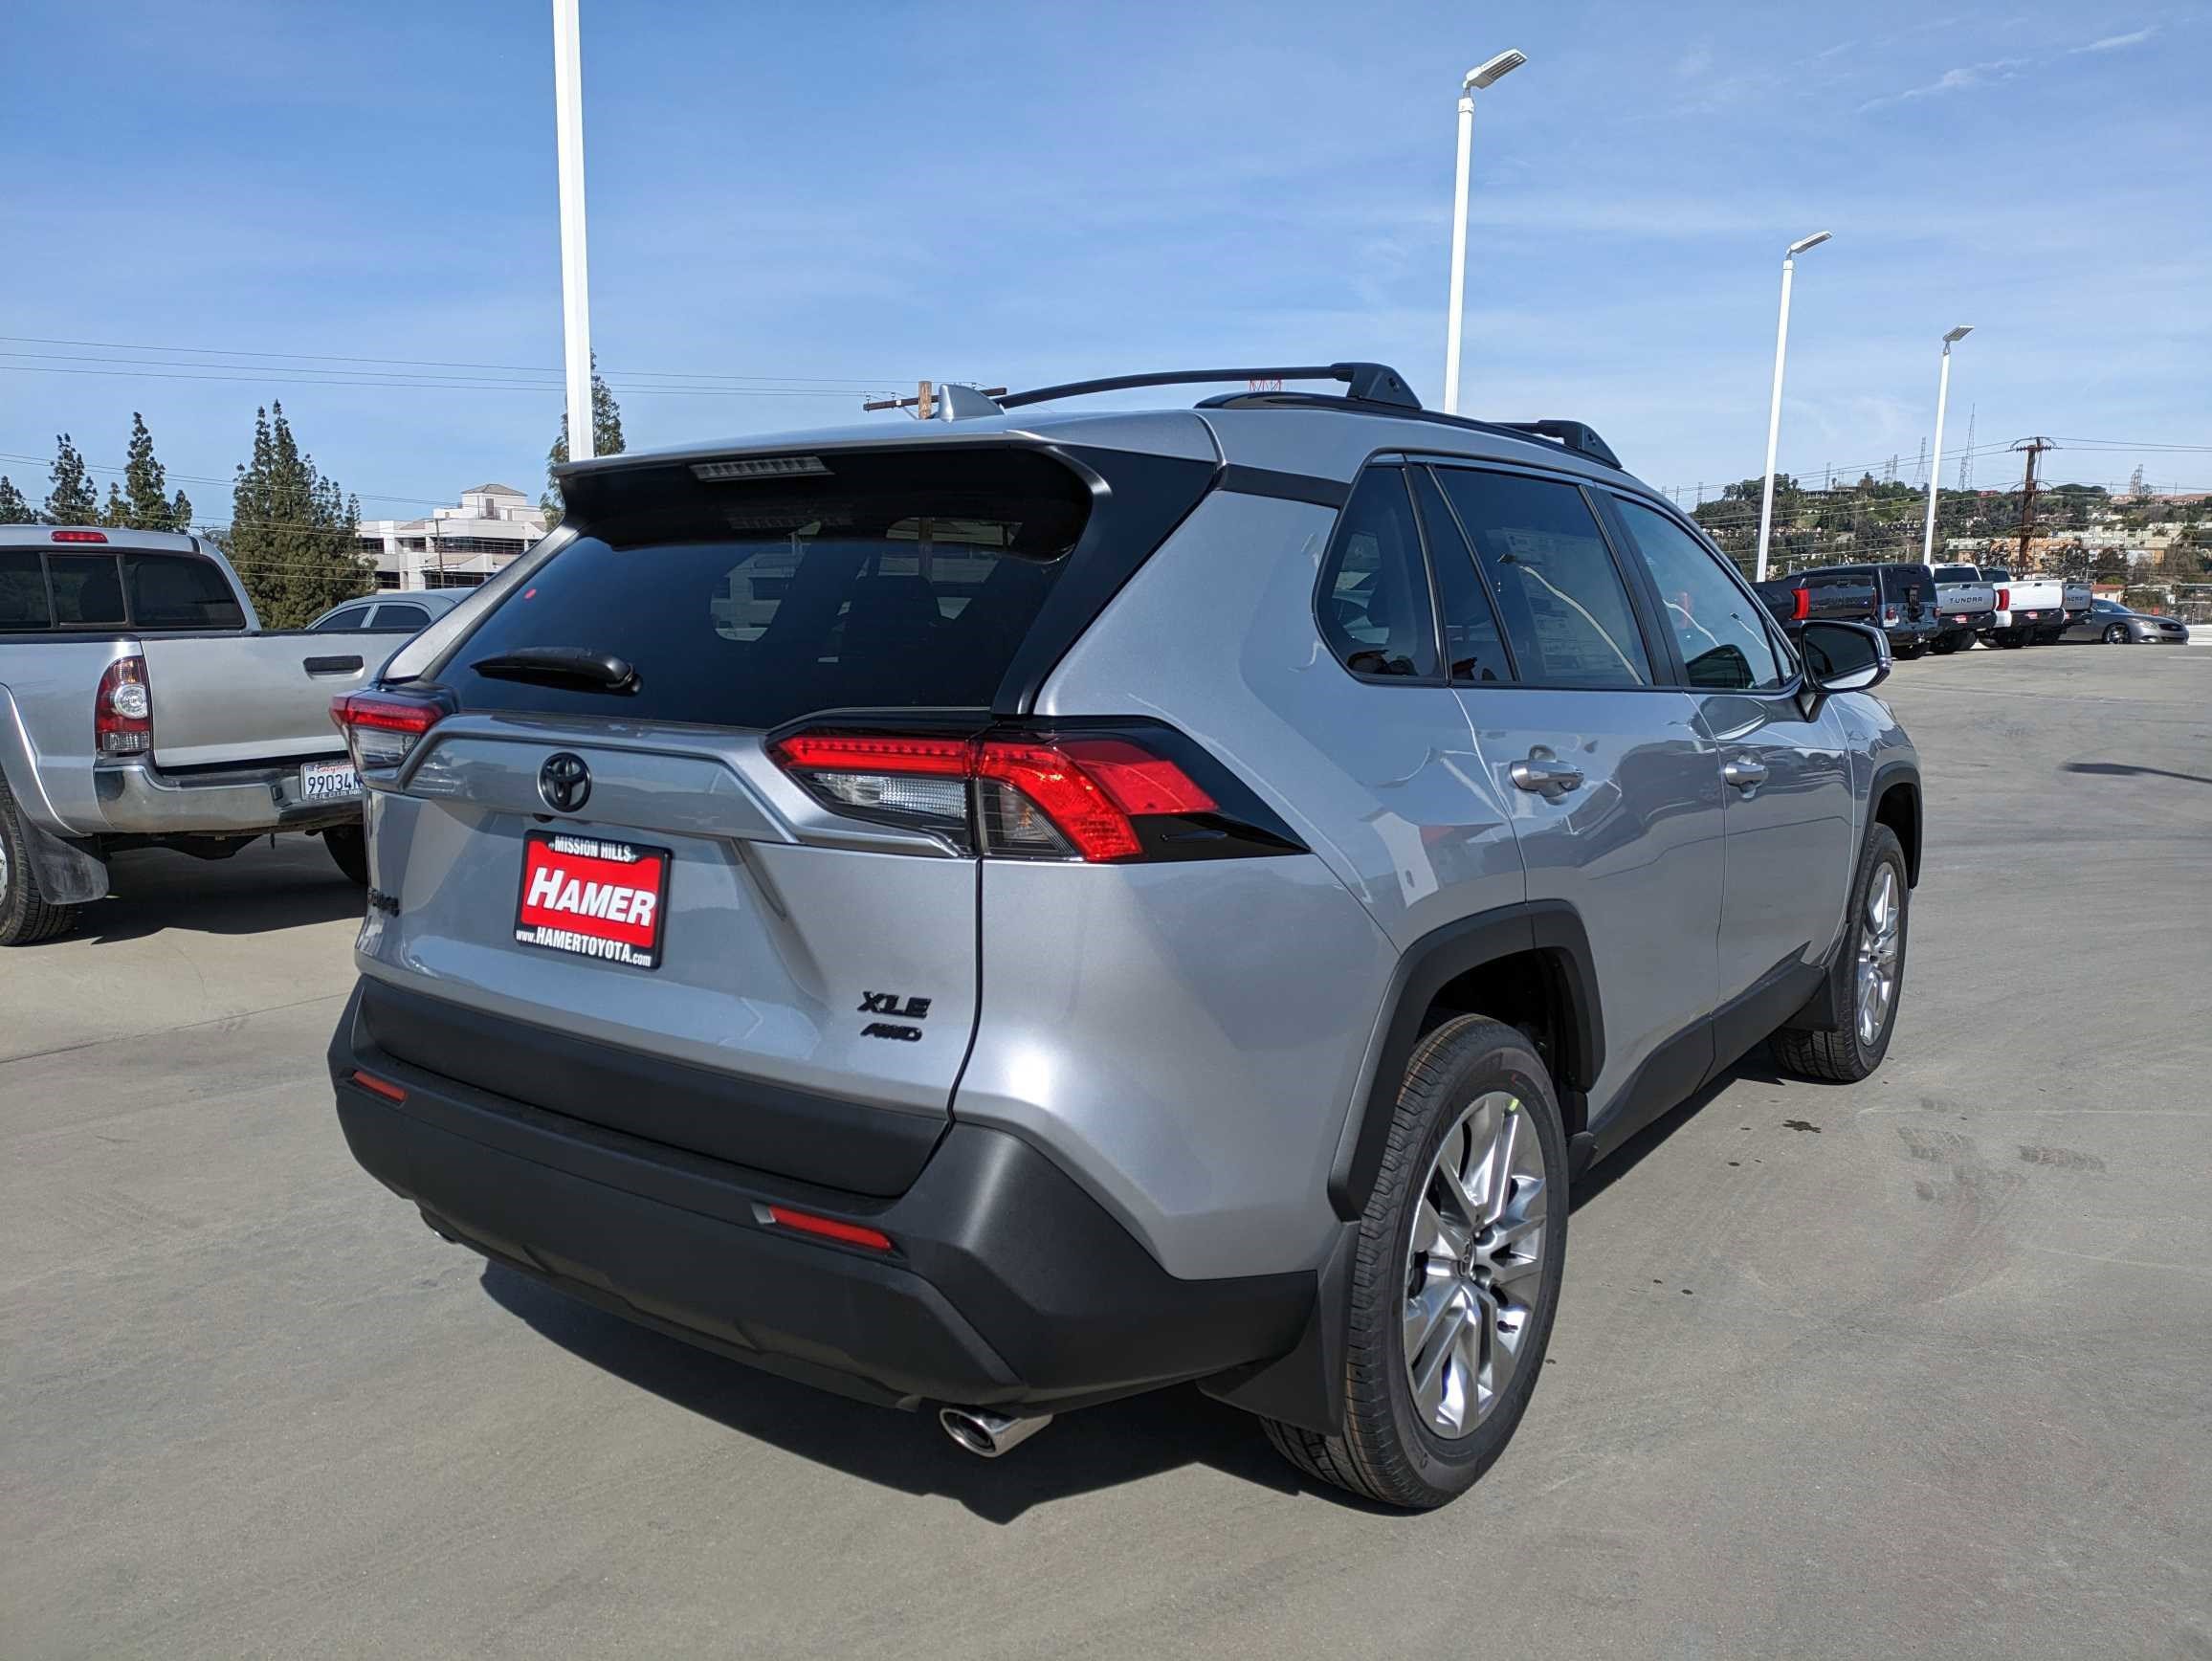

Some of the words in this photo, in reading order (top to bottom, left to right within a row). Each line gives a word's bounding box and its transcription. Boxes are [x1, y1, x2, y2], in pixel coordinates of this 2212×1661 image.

[555, 836, 598, 857] MISSION
[601, 842, 631, 862] HILLS
[526, 866, 656, 927] HAMER
[516, 927, 652, 967] www.HAMERTOYOTA.com
[857, 991, 932, 1020] XLE
[860, 1023, 922, 1042] AWD
